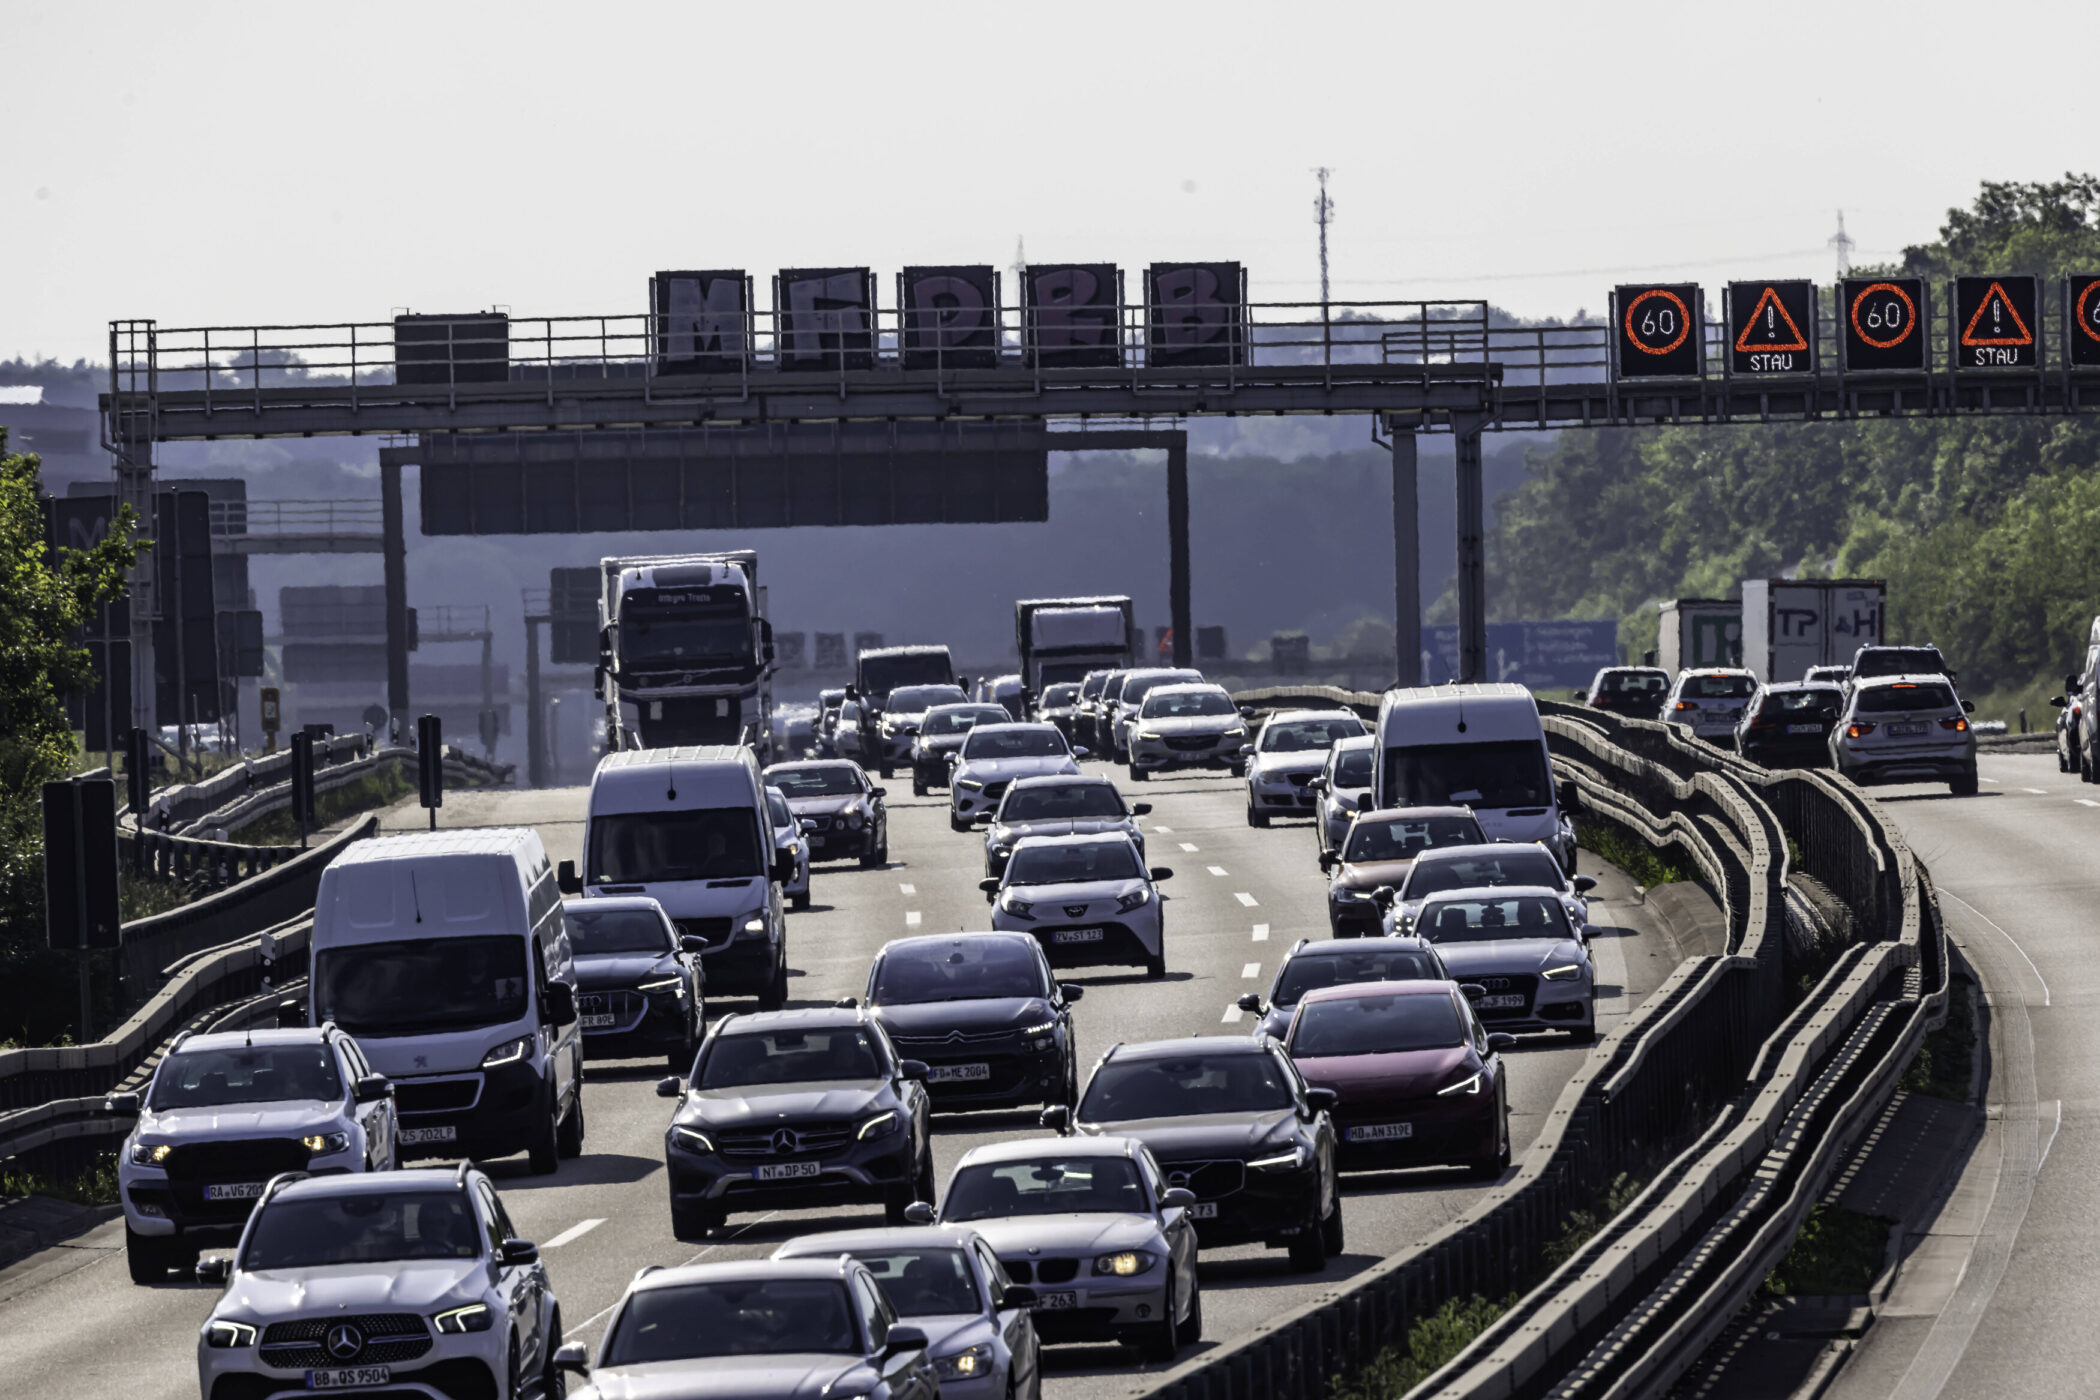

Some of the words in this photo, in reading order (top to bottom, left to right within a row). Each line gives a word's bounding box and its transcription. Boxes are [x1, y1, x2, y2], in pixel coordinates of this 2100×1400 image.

[1642, 309, 1675, 335] 60
[1867, 302, 1900, 328] 60
[1750, 353, 1794, 371] STAU
[1975, 347, 2019, 367] STAU
[420, 1128, 454, 1141] 202LP
[1372, 1126, 1385, 1137] AN
[763, 1166, 776, 1178] NT
[785, 1164, 800, 1176] DP
[801, 1163, 816, 1175] 50
[210, 1186, 224, 1198] RA
[231, 1184, 246, 1197] VG
[314, 1372, 331, 1387] BB
[339, 1371, 356, 1384] QS
[358, 1369, 388, 1383] 9504
